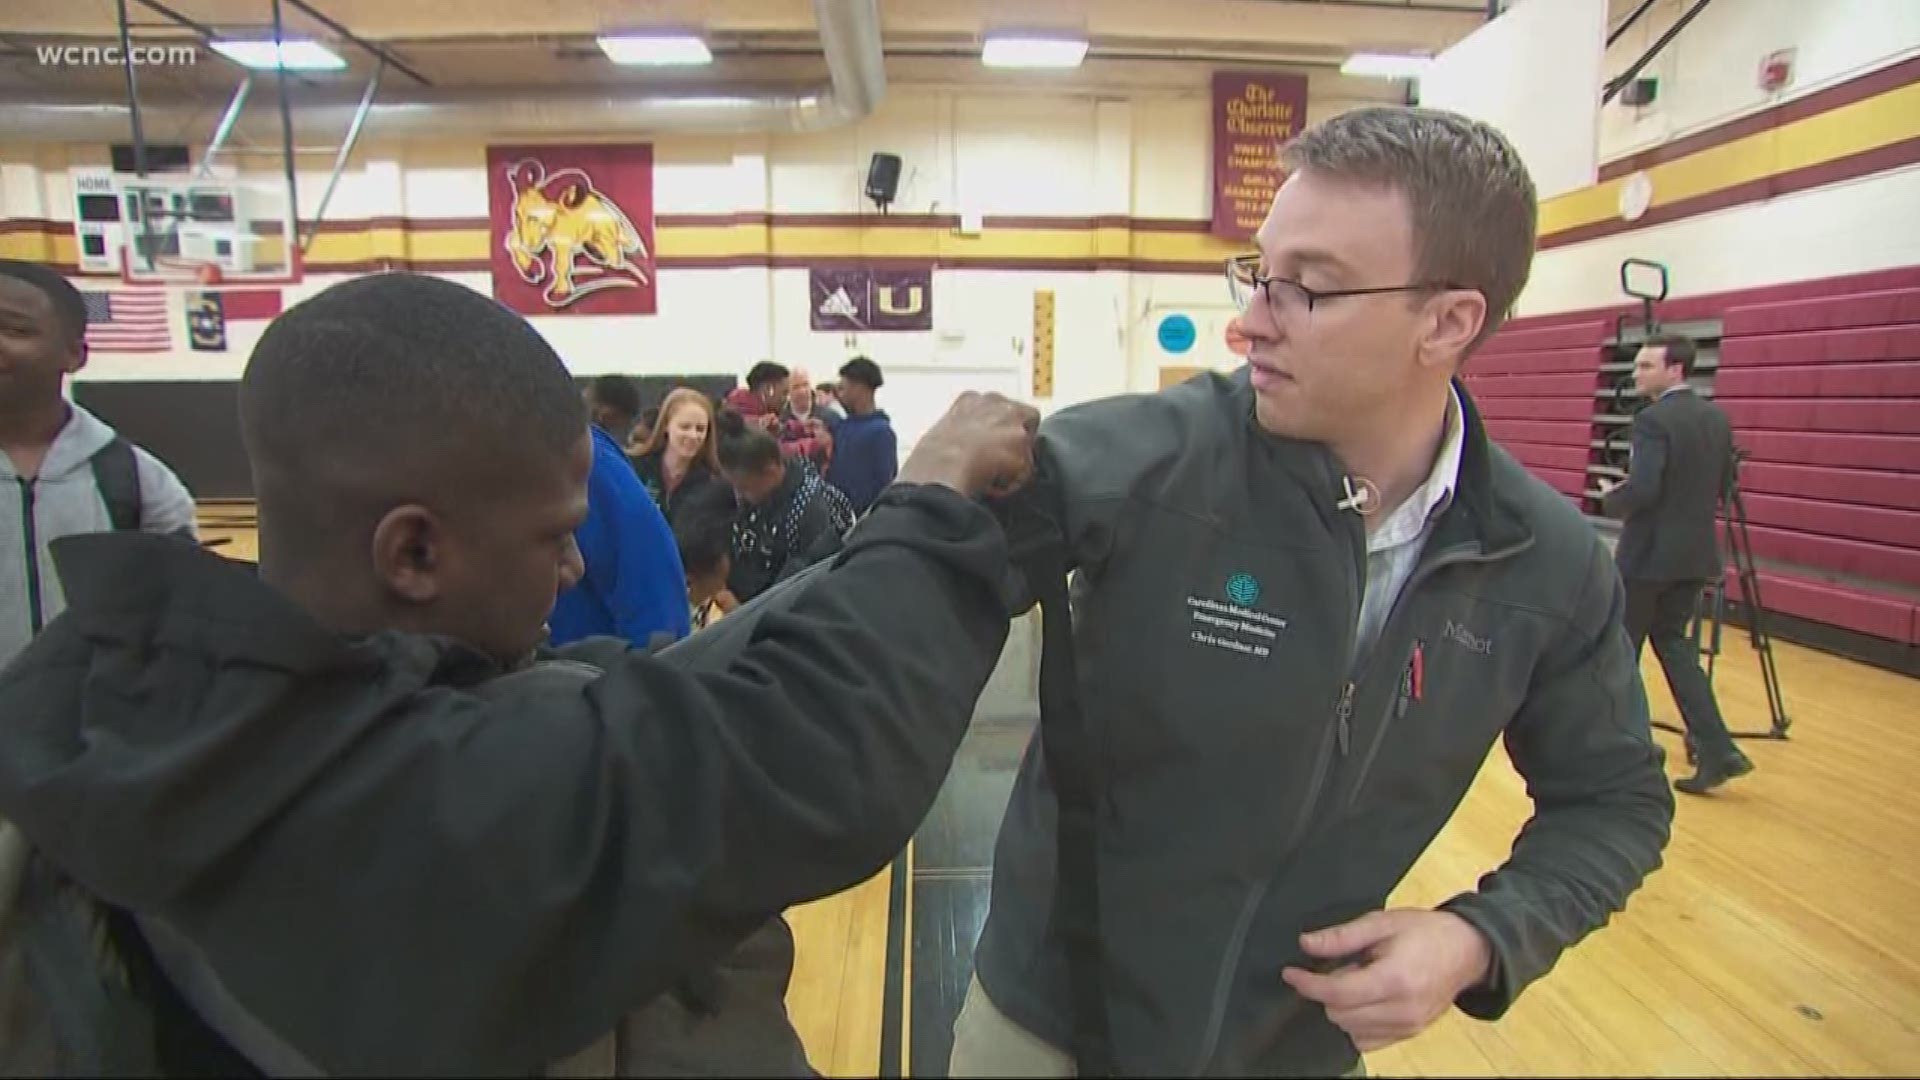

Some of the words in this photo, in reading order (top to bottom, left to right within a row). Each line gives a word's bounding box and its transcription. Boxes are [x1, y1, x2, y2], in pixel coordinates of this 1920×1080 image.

[1246, 83, 1275, 101] The
[1227, 97, 1293, 119] Charlotte
[1227, 116, 1292, 138] Observer
[77, 176, 111, 190] HOME
[879, 285, 923, 314] U
